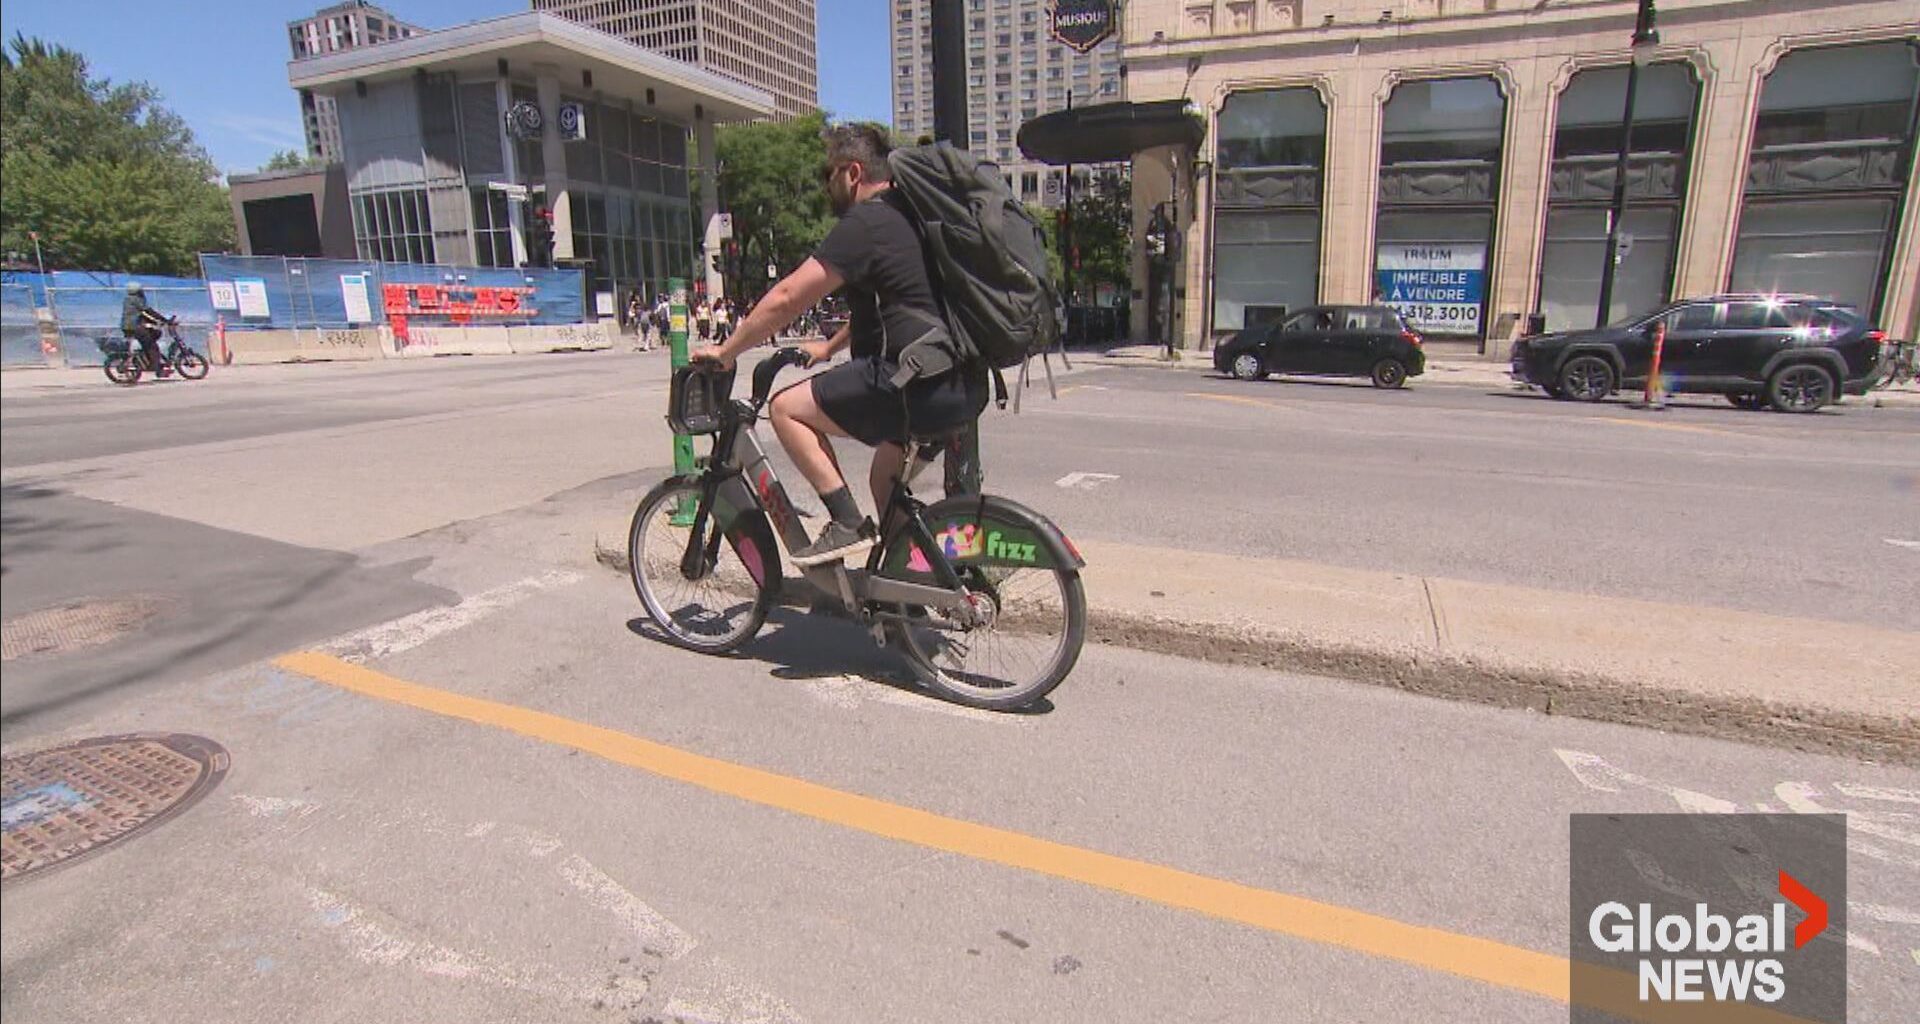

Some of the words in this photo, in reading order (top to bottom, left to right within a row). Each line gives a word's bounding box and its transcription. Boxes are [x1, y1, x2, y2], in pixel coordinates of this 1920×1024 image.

[1393, 272, 1467, 284] IMMEUBLE
[1392, 286, 1402, 299] À
[1407, 288, 1466, 300] VENDRE
[987, 530, 1036, 562] fizz
